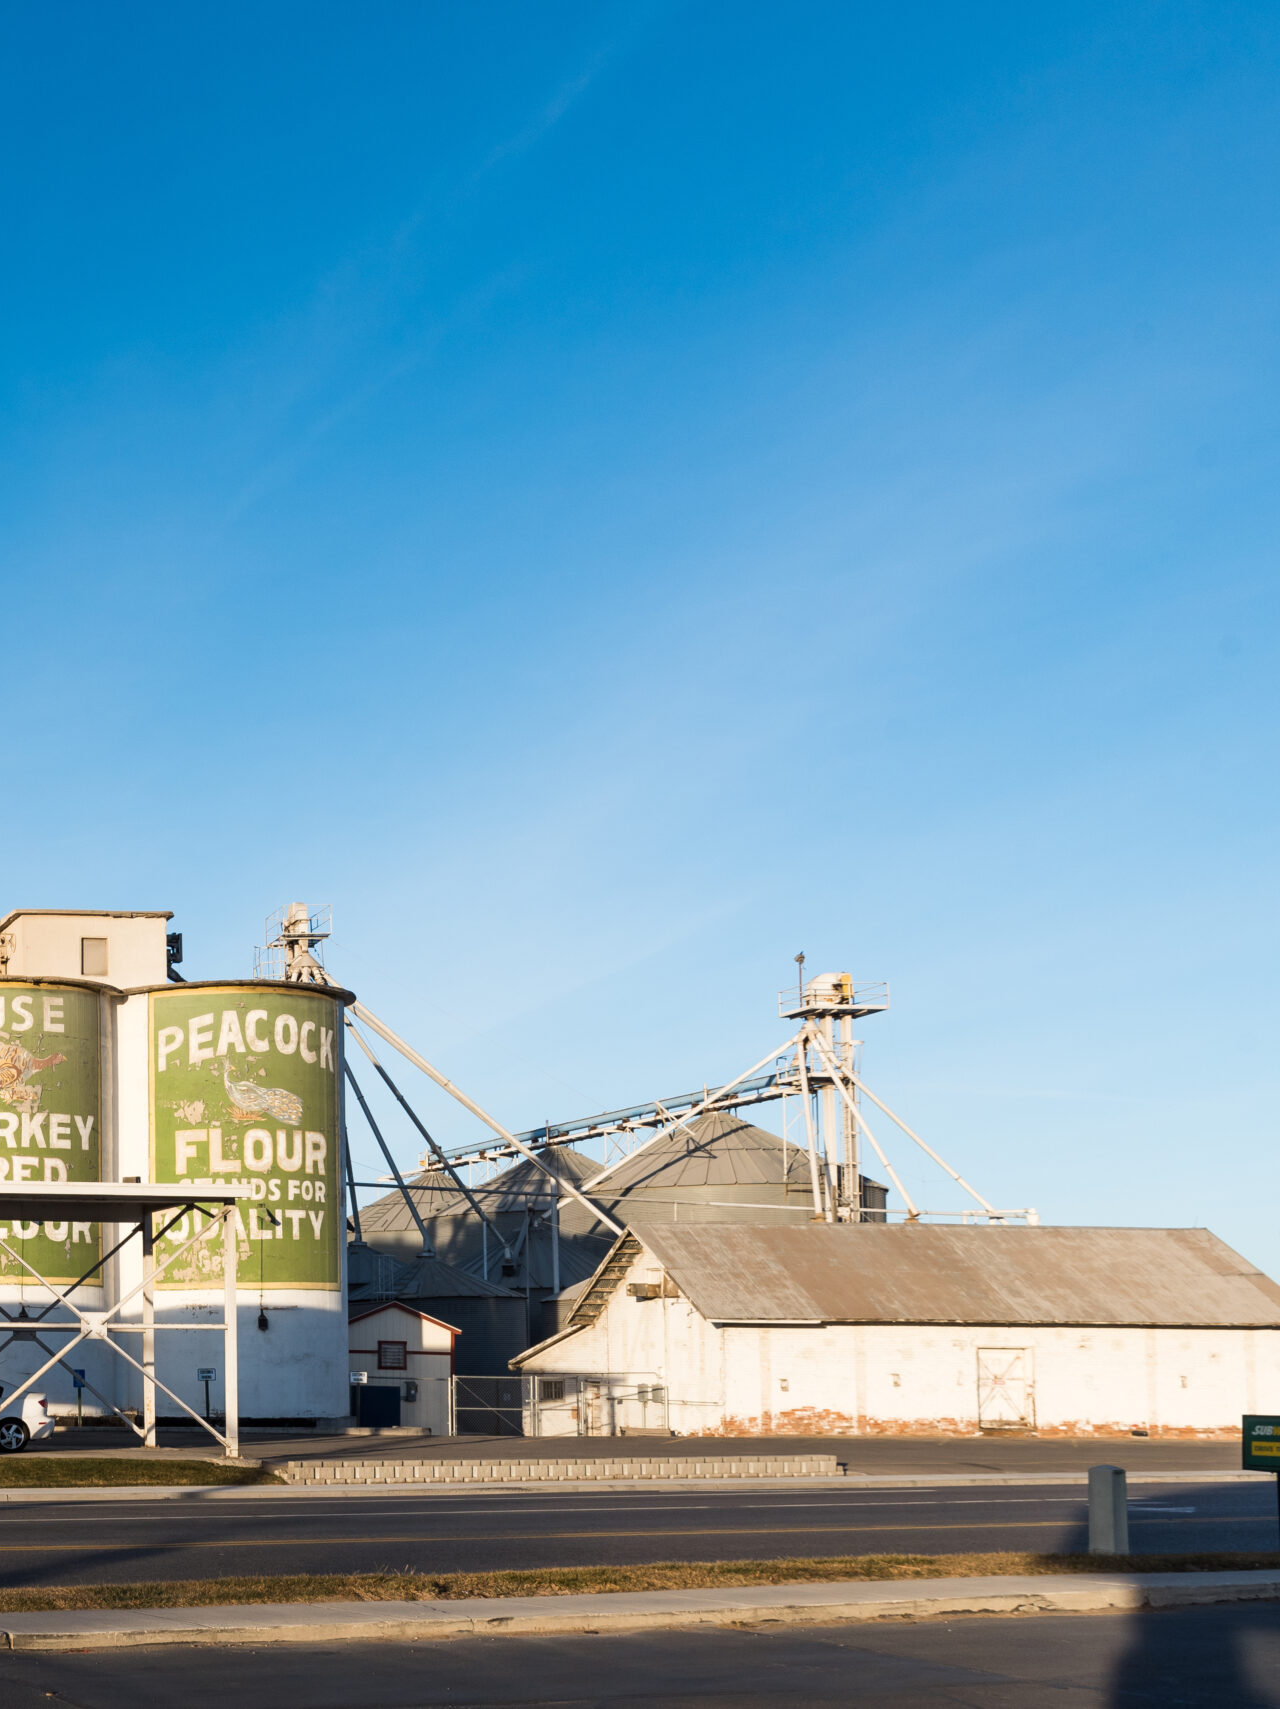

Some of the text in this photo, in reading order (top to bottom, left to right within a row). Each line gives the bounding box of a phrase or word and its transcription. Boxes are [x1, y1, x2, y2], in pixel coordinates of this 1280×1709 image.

[157, 1009, 335, 1073] PEACOCK
[175, 1128, 327, 1176] FLOUR
[287, 1179, 326, 1203] FOR
